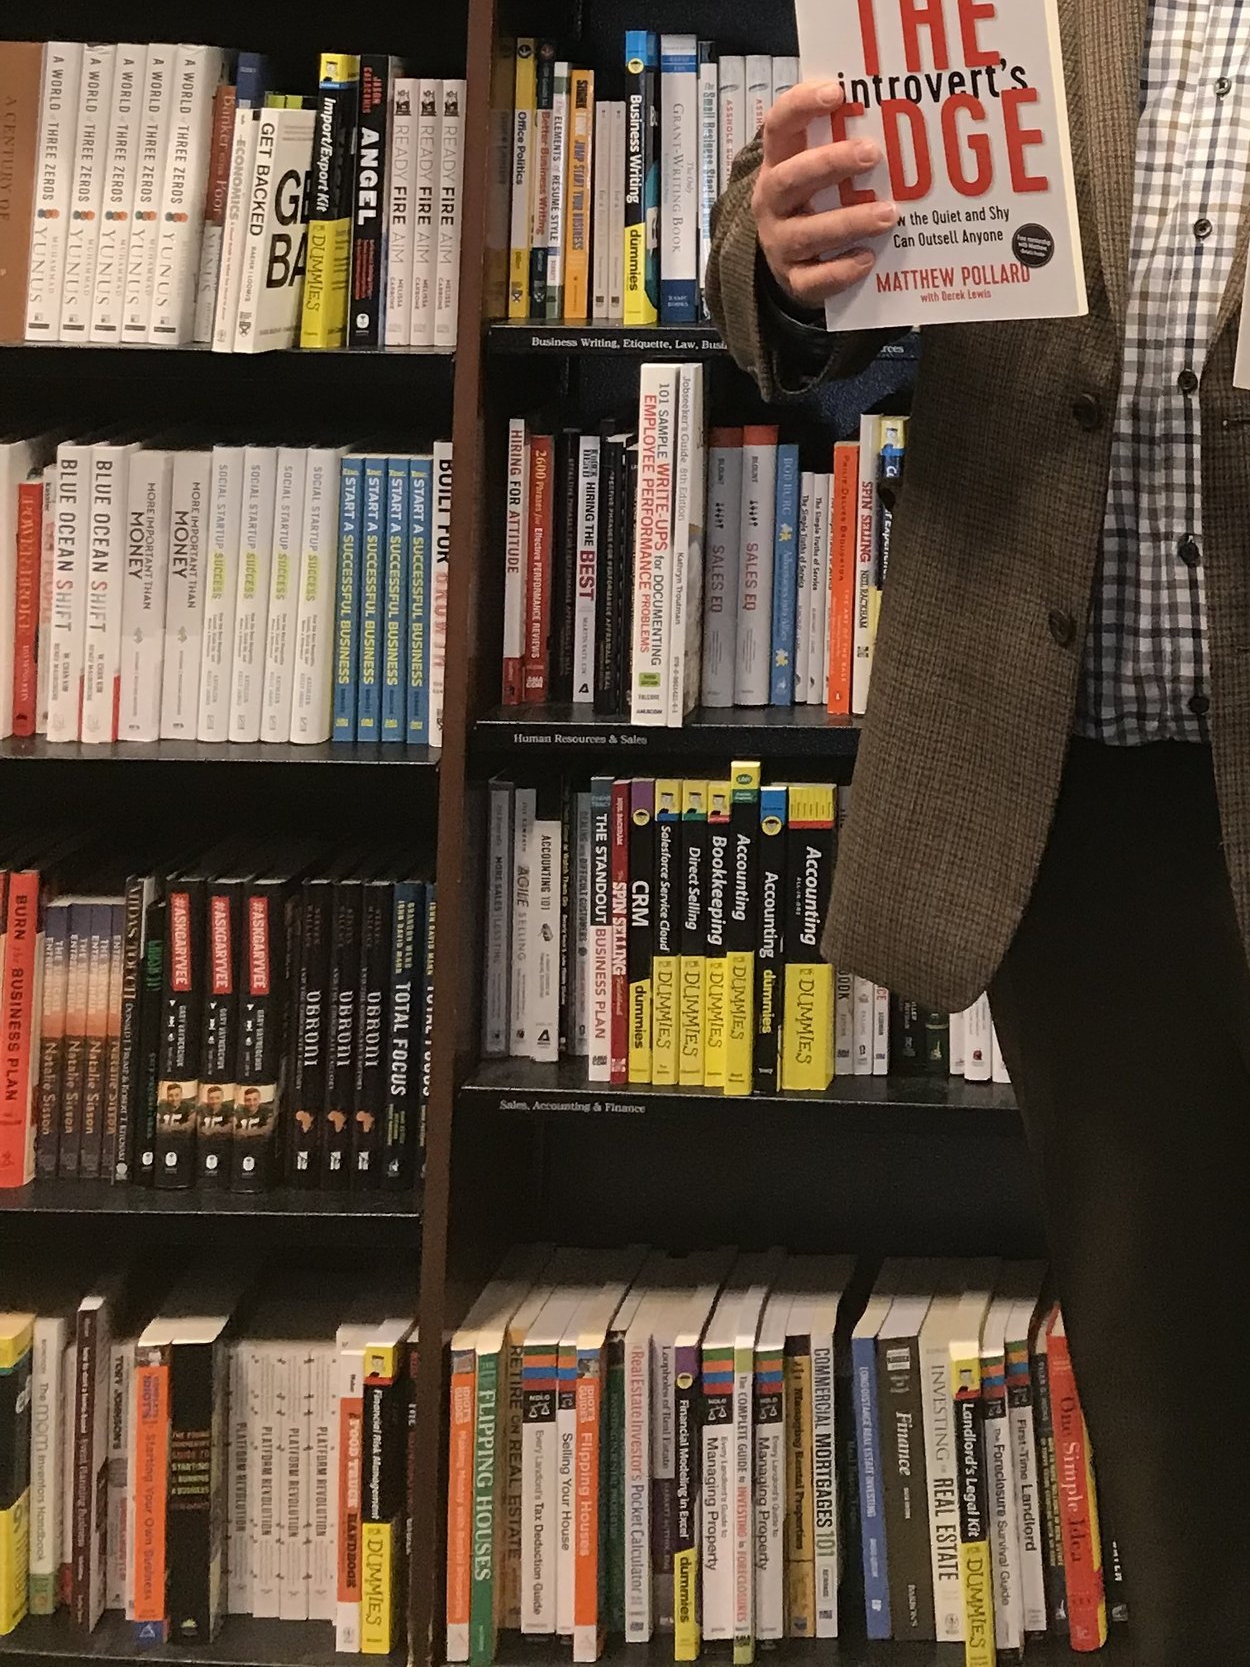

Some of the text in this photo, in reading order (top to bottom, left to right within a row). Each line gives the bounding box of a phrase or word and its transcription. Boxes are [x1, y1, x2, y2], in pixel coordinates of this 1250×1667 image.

[839, 58, 1028, 109] introvert's
[249, 123, 275, 237] GET BACKED
[357, 127, 379, 225] ANGEL
[830, 87, 1049, 206] EDGE
[627, 94, 643, 291] Business Writing dummies
[910, 207, 1009, 226] the Quiet and Shy
[876, 263, 1030, 294] MATTHEW POLLARD
[894, 229, 1003, 249] Can Outsell Anyone
[921, 289, 991, 303] with Derek Lewis
[532, 337, 727, 349] Business Writing, Etiquette, Law, Busi
[54, 459, 78, 631] BLUE OCEAN SHIFT
[514, 734, 647, 744] Human Resources & Sales
[707, 836, 727, 945] Bookkeeping
[734, 834, 750, 922] Accounting
[759, 872, 778, 959] Accounting
[800, 846, 821, 945] Accounting
[171, 894, 190, 985] #ASKGARYVEE
[632, 880, 649, 1049] CRM dummies
[390, 982, 411, 1097] TOTAL FOCUS
[500, 1101, 646, 1114] Sales, Accounting & Finance
[475, 1388, 495, 1582] FLIPPING HOUSES
[814, 1348, 834, 1557] COMMERCIAL MORTGAGES 101
[364, 1538, 382, 1626] DUMMIES
